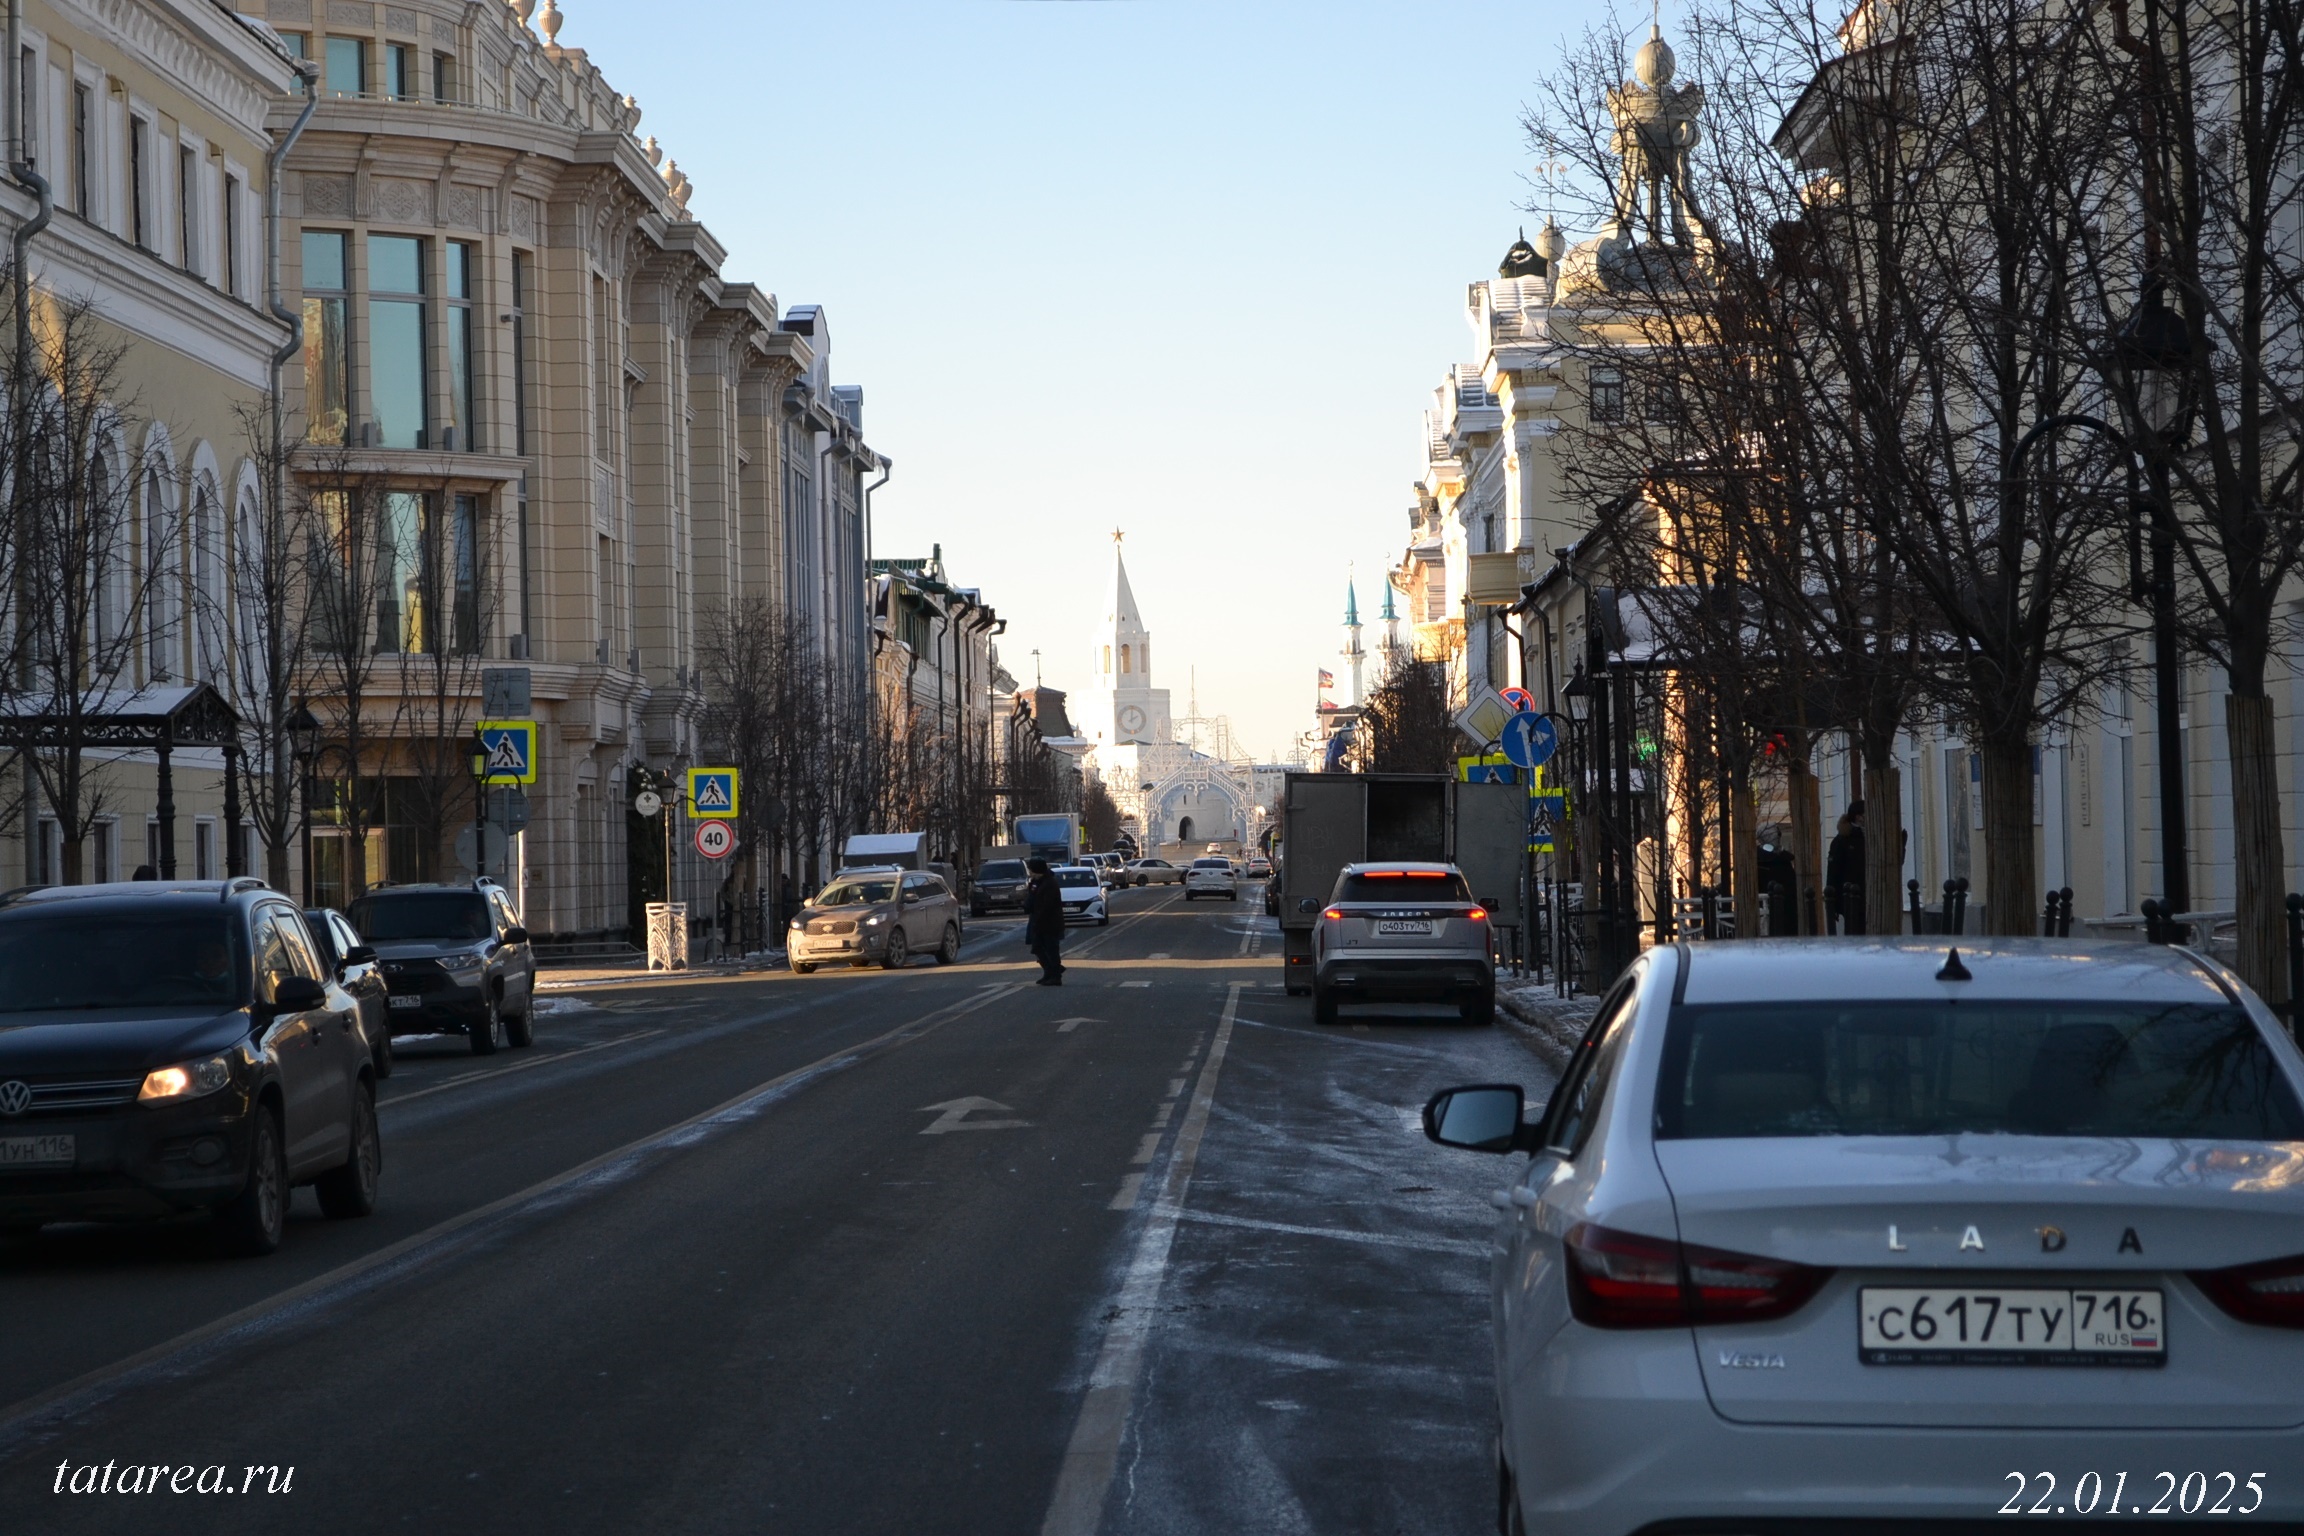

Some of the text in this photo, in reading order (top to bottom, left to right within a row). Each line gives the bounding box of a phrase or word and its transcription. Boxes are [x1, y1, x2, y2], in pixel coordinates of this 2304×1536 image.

[704, 832, 723, 846] 40
[1382, 921, 1429, 931] О403ТУ 716
[38, 1136, 68, 1153] 116
[1888, 1224, 2144, 1254] LADA
[1877, 1295, 2148, 1342] С617ТУ 716
[2095, 1332, 2130, 1346] RUS
